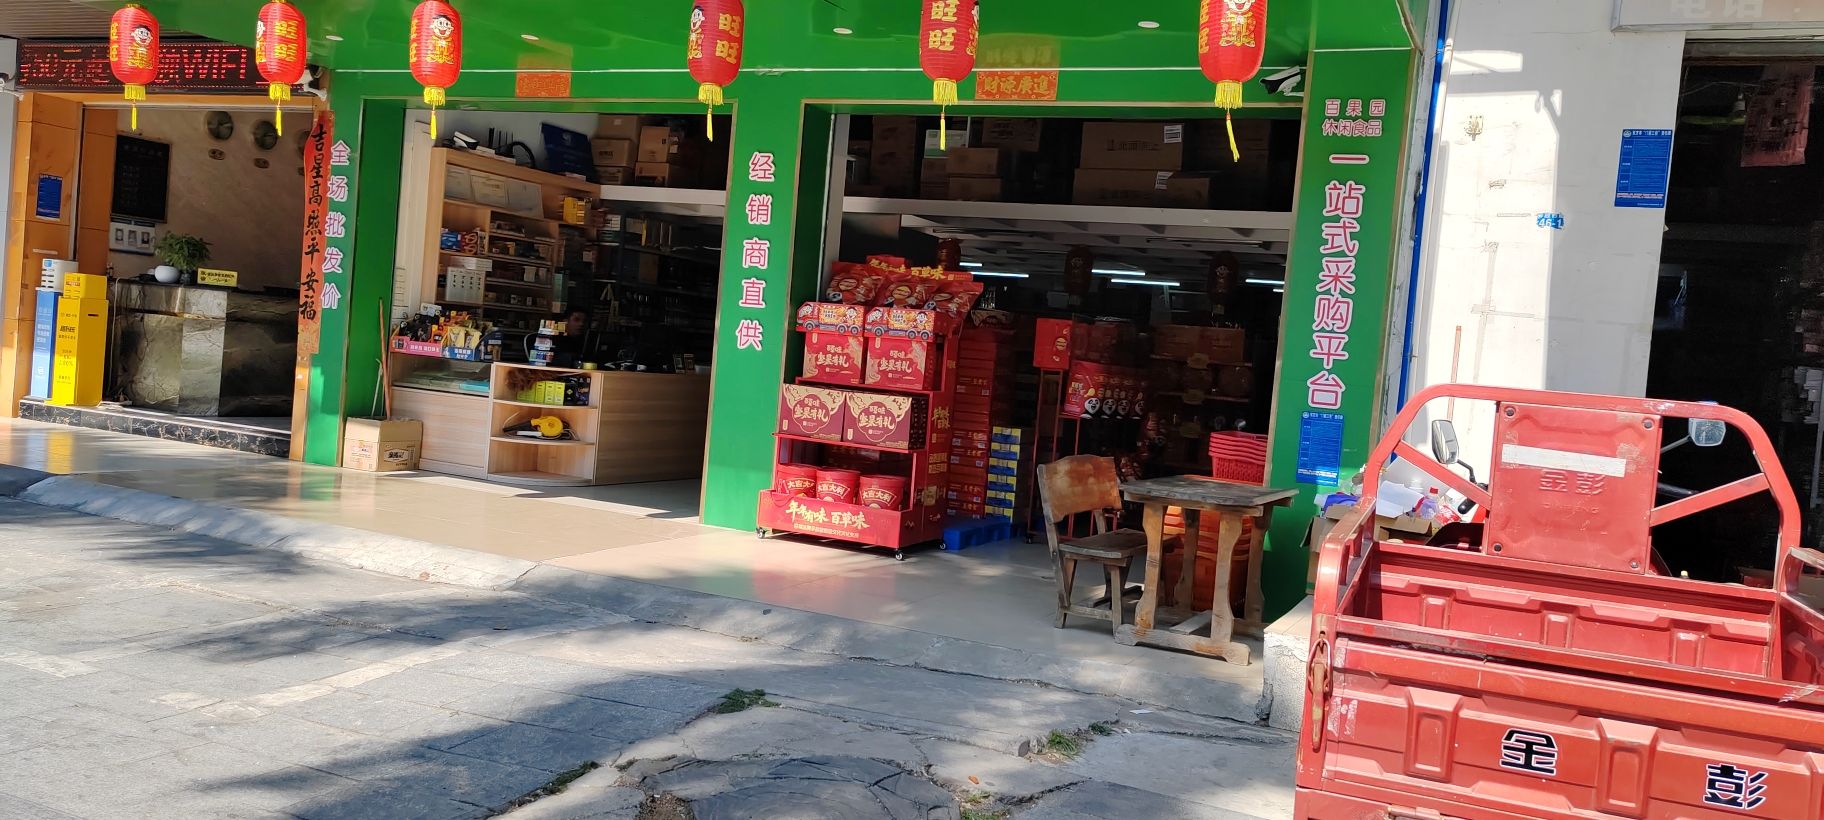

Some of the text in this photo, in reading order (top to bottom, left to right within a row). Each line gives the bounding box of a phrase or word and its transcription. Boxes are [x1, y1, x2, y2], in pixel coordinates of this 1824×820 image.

[715, 13, 741, 64] 旺旺
[929, 0, 960, 51] 旺旺
[1322, 118, 1382, 137] 休闲食品
[1325, 98, 1385, 117] 百果园
[299, 123, 328, 321] 吉星高照平安福
[321, 140, 351, 310] 全场批发价
[735, 151, 775, 352] 经销商直供
[1307, 153, 1370, 410] 一站式采购平台
[831, 511, 871, 530] 百草味
